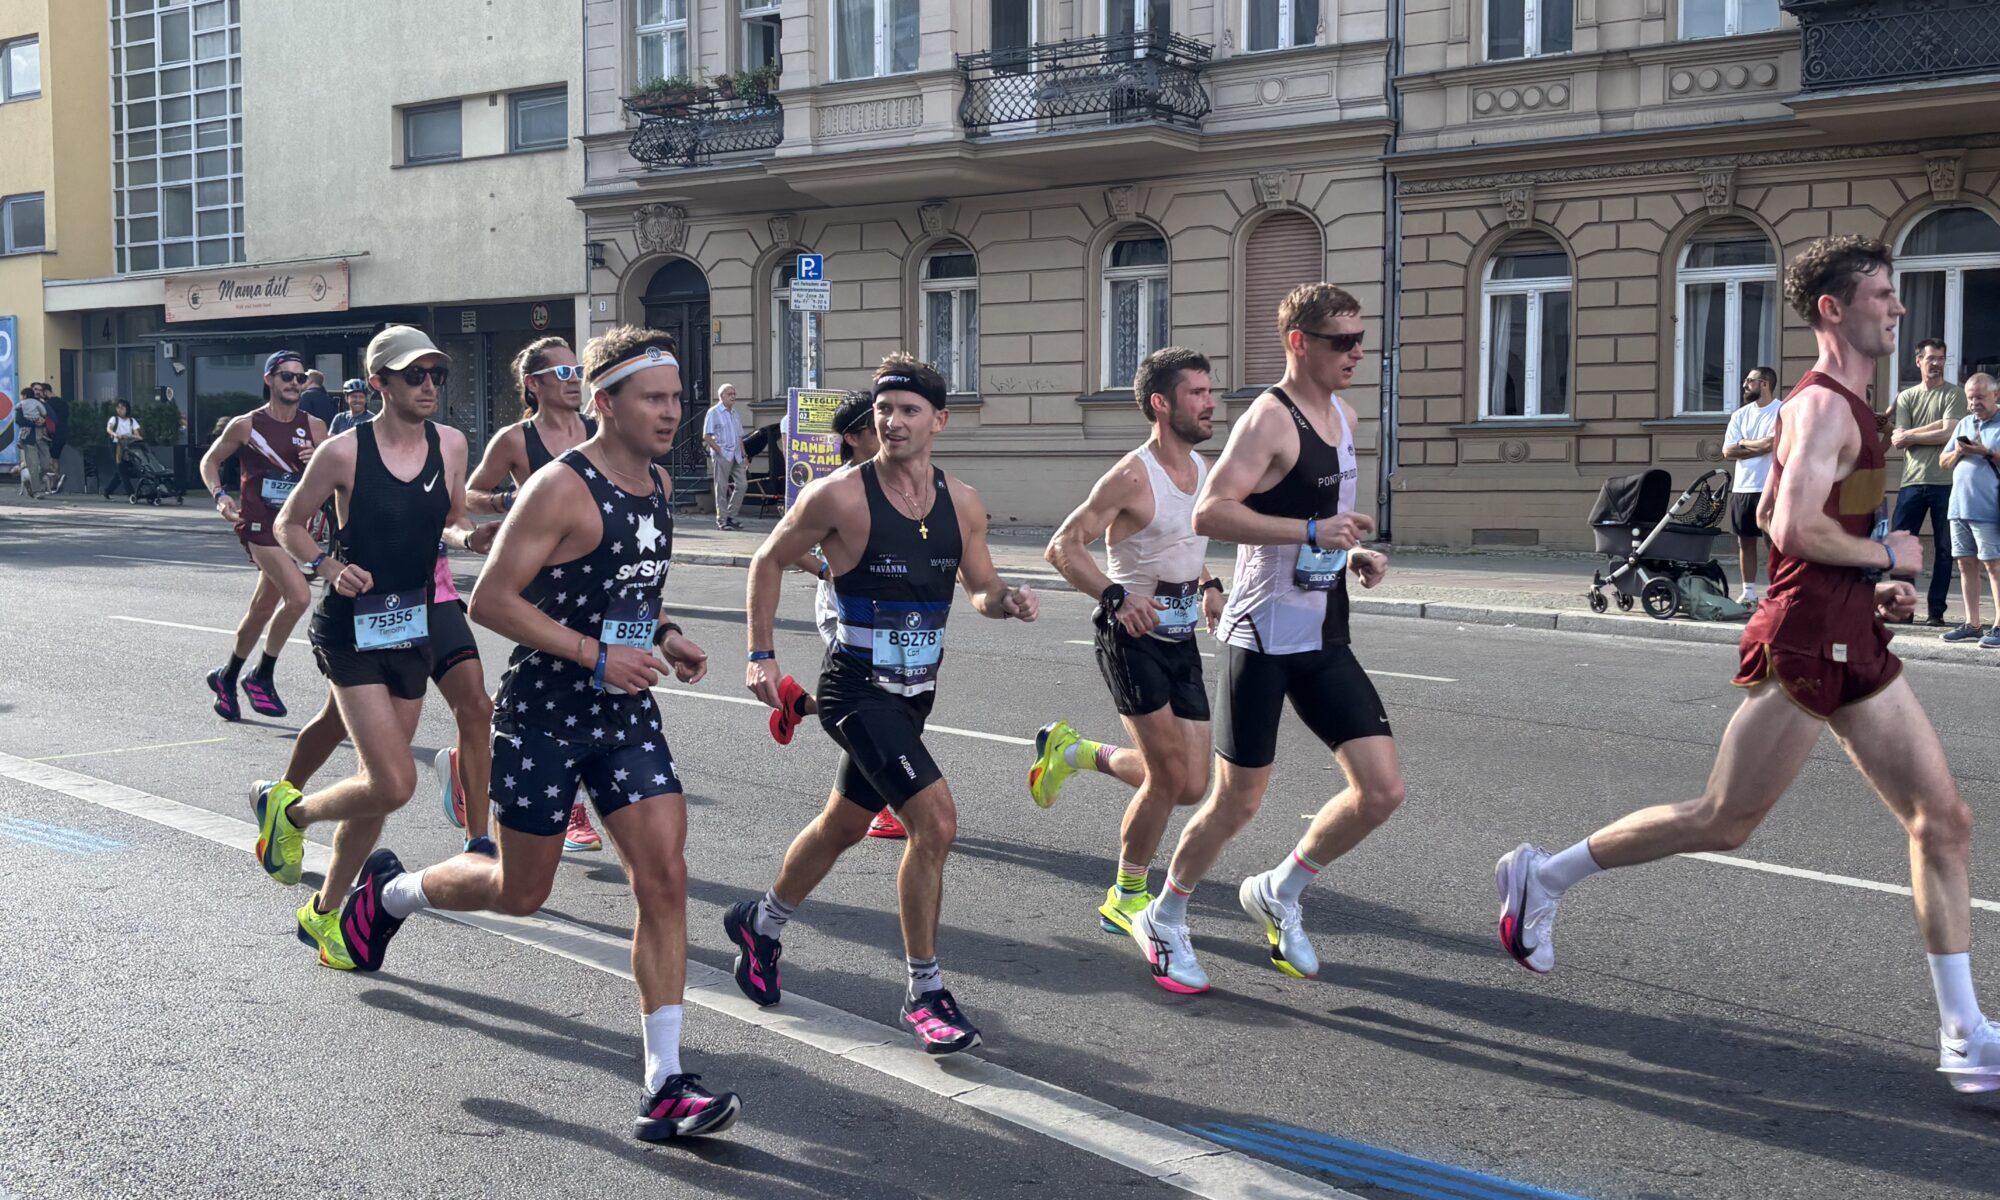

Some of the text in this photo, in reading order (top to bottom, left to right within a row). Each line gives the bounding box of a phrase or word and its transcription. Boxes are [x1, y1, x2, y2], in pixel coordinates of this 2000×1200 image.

[801, 257, 816, 278] P
[218, 279, 263, 301] Mama
[102, 316, 112, 340] 4
[802, 397, 841, 405] STEGLIT
[791, 439, 835, 454] RAMBA
[869, 564, 908, 574] HAVANNA
[368, 609, 413, 629] 75356
[888, 630, 937, 647] 89278
